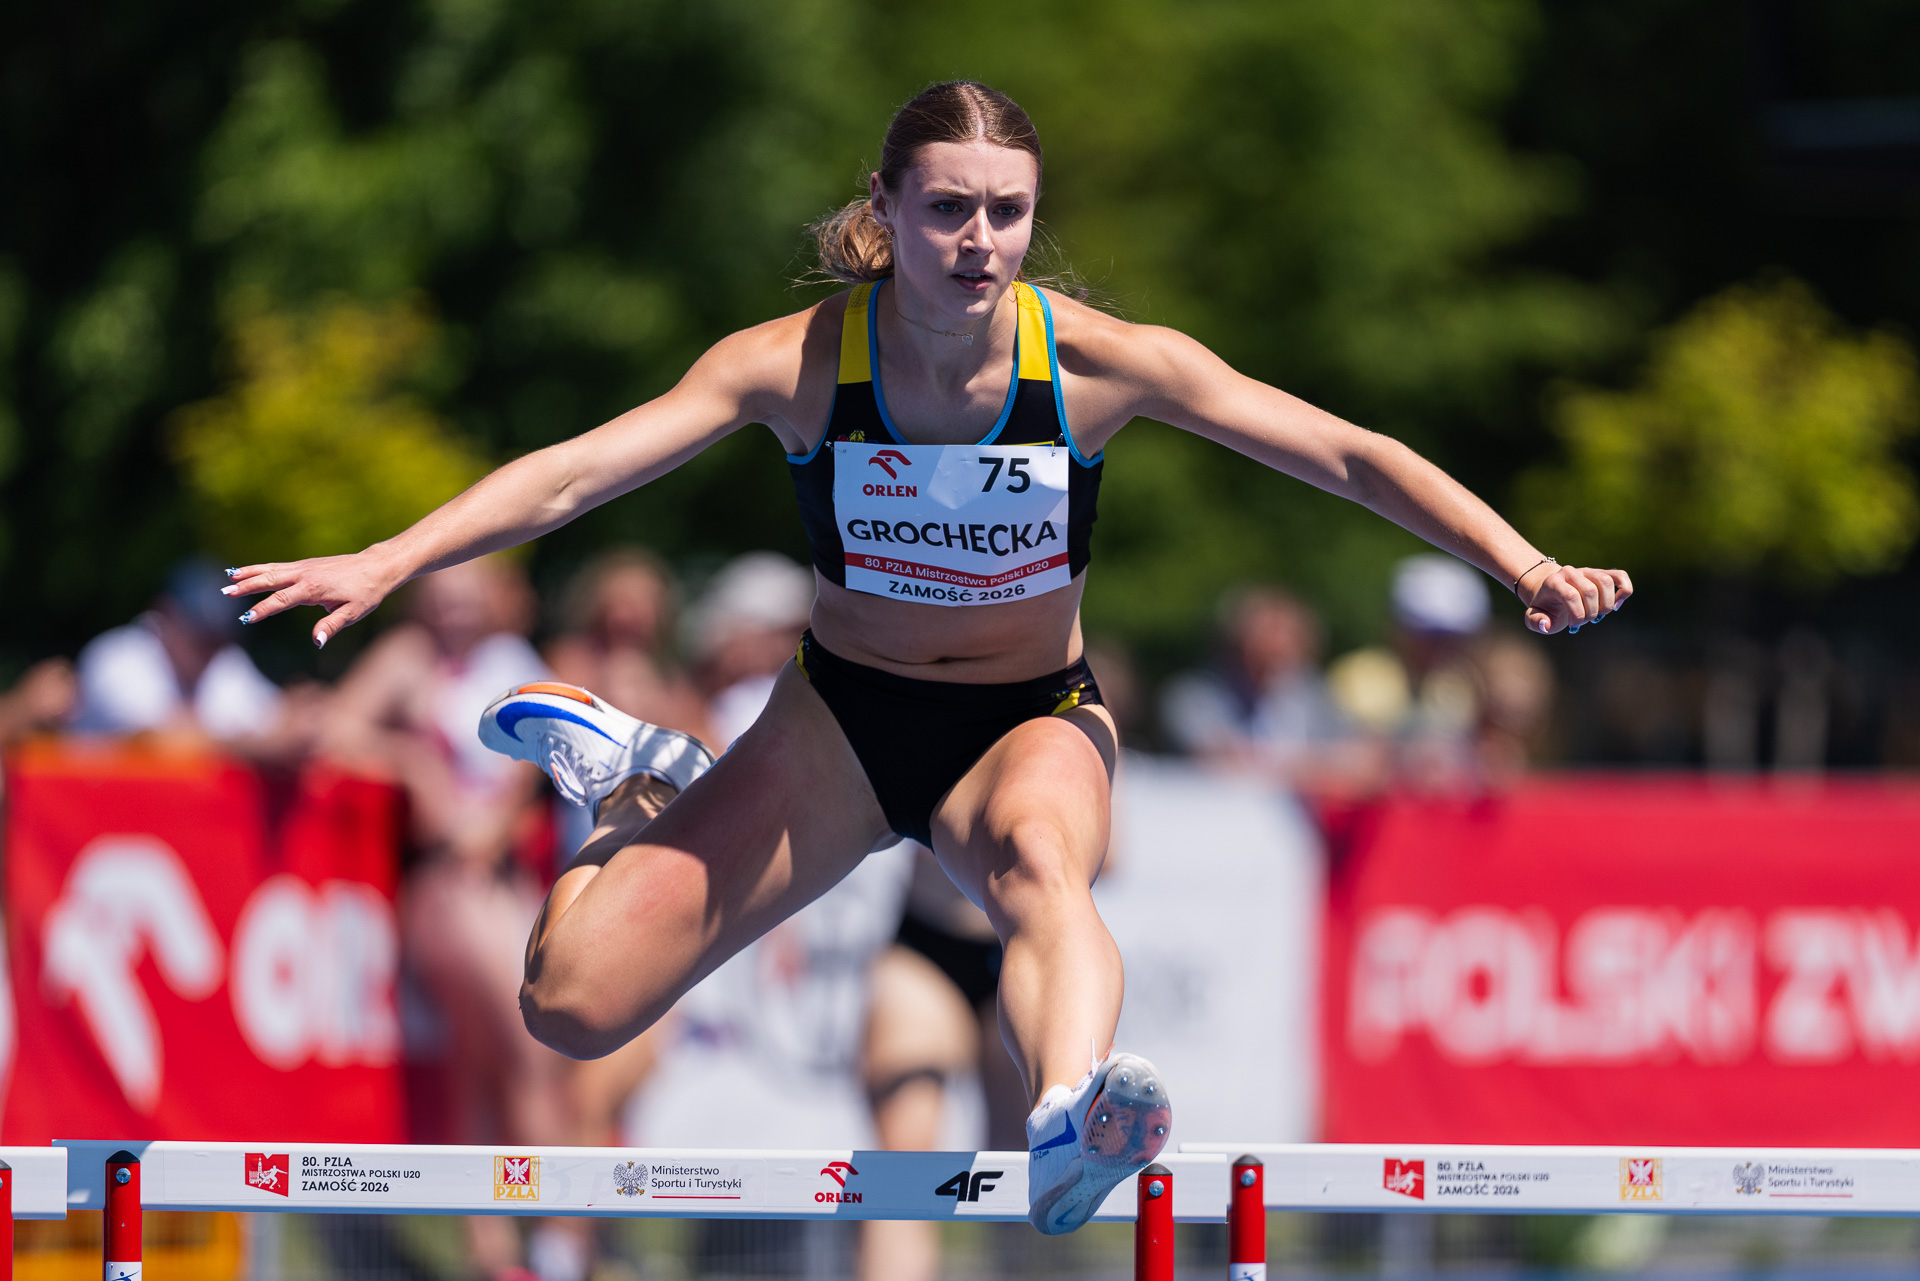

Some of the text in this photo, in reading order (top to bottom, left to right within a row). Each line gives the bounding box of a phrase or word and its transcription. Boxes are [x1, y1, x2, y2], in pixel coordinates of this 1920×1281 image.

[978, 457, 1031, 494] 75
[862, 483, 918, 498] ORLEN
[847, 518, 1058, 557] GROCHECKA
[864, 557, 1049, 586] 80. PZLA Mistrzostwa Polski U20
[888, 580, 1026, 602] ZAMOŚĆ 2026
[301, 1156, 353, 1167] 80. PZLA
[1458, 1161, 1485, 1171] PZLA
[301, 1168, 421, 1179] MISTRZOSTWA POLSKI U20
[651, 1165, 720, 1176] Ministerstwo
[1768, 1165, 1833, 1175] Ministerstwo
[301, 1178, 390, 1193] ZAMOŚĆ 2026
[651, 1177, 742, 1190] Sportu i Turystyki
[934, 1170, 1004, 1202] 4F
[1768, 1177, 1801, 1188] Sportu
[1810, 1177, 1854, 1189] Turystyki
[496, 1186, 537, 1199] PZLA
[1492, 1185, 1520, 1195] 2026
[814, 1192, 863, 1204] ORLEN
